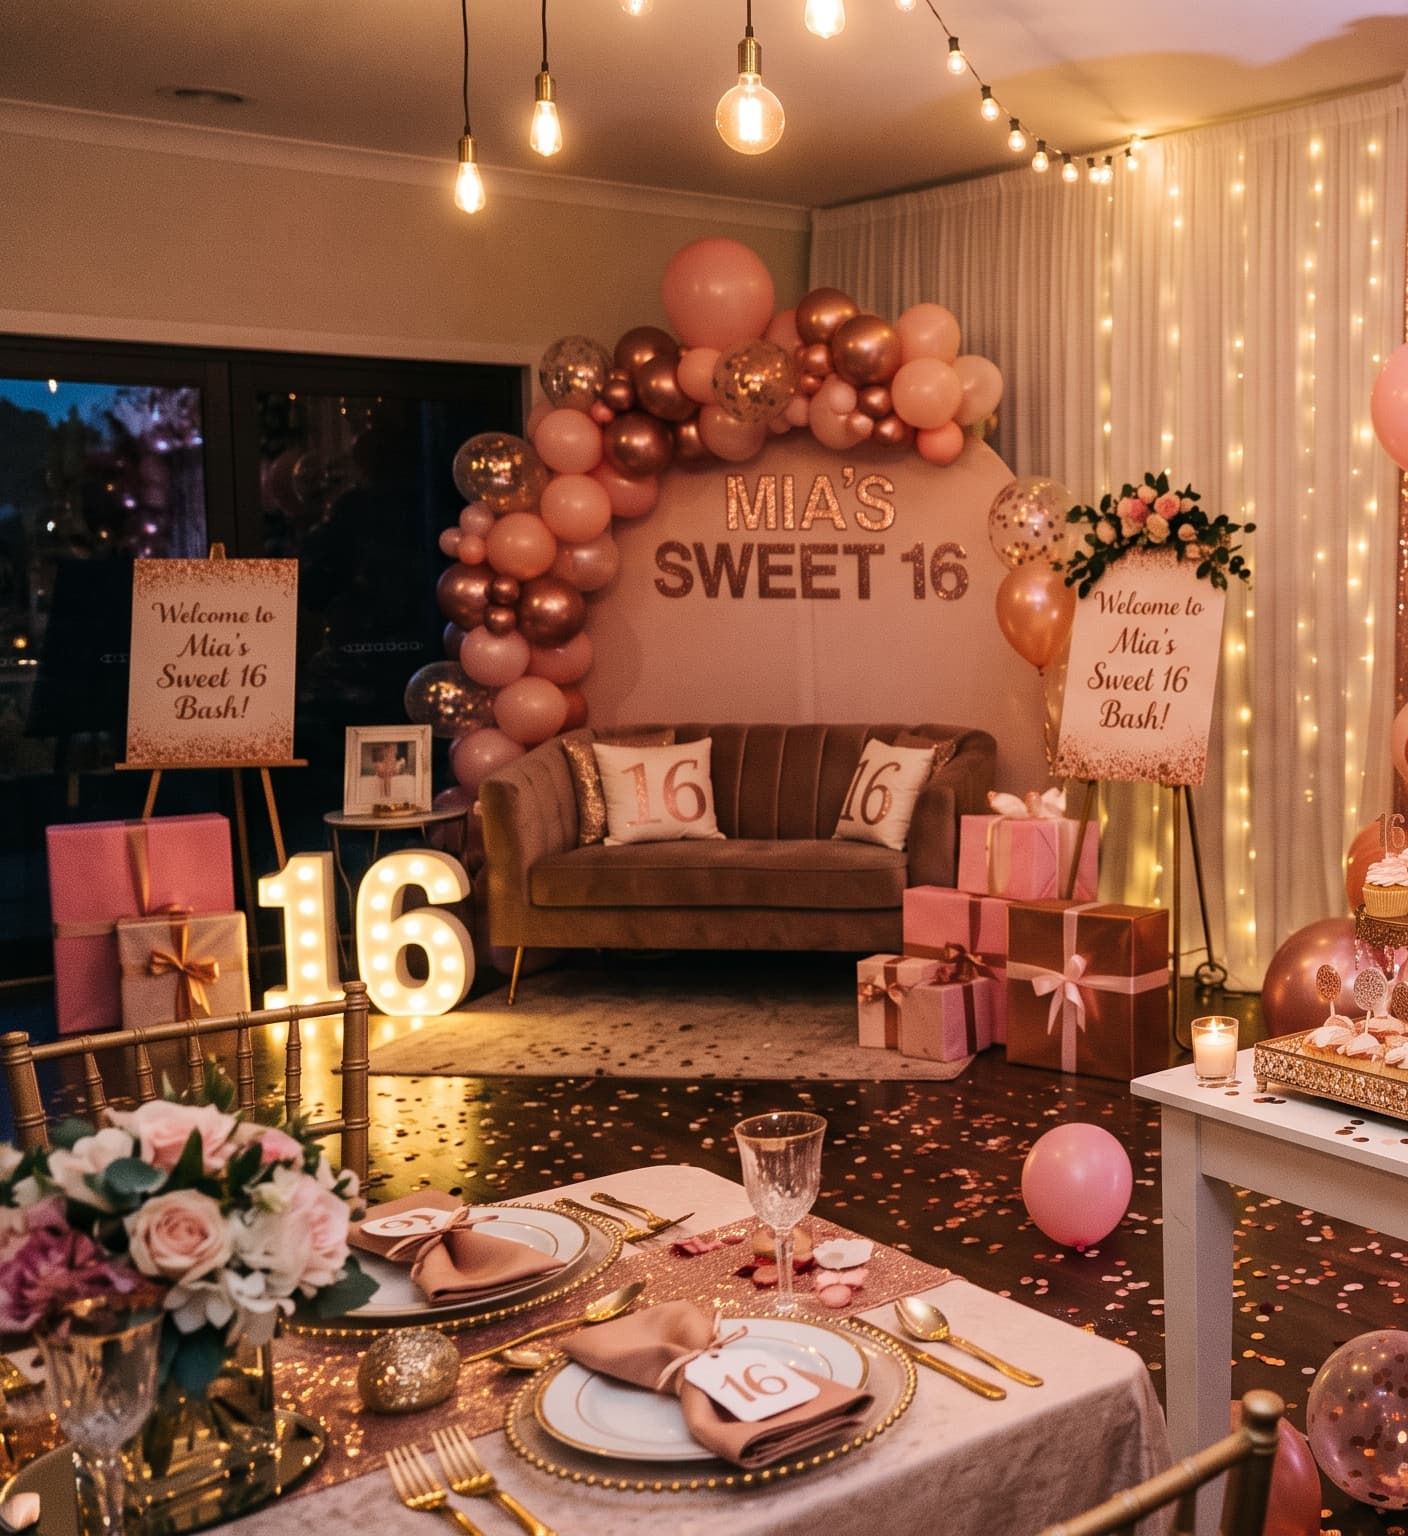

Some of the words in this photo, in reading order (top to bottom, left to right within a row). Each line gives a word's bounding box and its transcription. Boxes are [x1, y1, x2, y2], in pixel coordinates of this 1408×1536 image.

[726, 466, 896, 532] MIA'S
[654, 541, 886, 600] SWEET
[901, 541, 970, 600] 16
[151, 601, 249, 624] Welcome
[255, 605, 277, 623] to
[1094, 590, 1181, 616] Welcome
[1185, 596, 1205, 616] to
[176, 632, 250, 658] Mia's
[1108, 627, 1177, 655] Mia's
[156, 663, 231, 689] Sweet
[240, 664, 267, 688] 16
[1087, 661, 1155, 692] Sweet
[1163, 665, 1190, 693] 16
[173, 695, 250, 720] Bash!
[1099, 699, 1170, 731] Bash!
[620, 759, 708, 826] 16
[840, 759, 901, 826] 16
[1375, 812, 1406, 851] 16
[258, 848, 475, 1017] 16
[719, 1363, 788, 1402] 16
